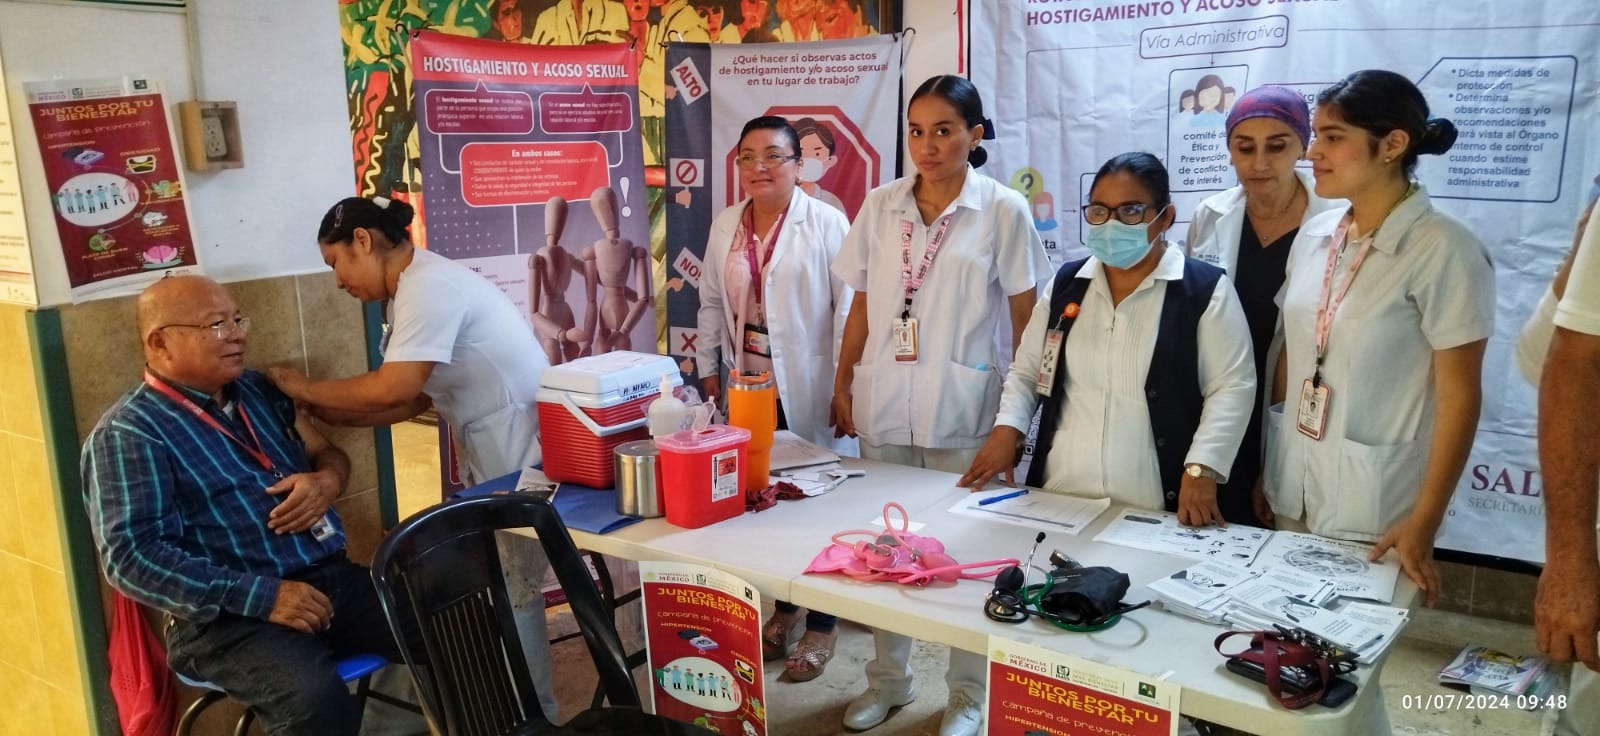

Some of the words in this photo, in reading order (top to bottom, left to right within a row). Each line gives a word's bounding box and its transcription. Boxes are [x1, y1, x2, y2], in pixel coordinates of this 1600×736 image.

[1026, 1, 1174, 26] HOSTIGAMIENTO
[1182, 0, 1191, 13] Y
[1146, 35, 1171, 49] Vía
[1175, 25, 1285, 47] Administrativa
[732, 54, 757, 66] ¿Qué
[760, 53, 788, 63] hacer
[791, 53, 799, 62] si
[801, 53, 846, 63] observas
[849, 51, 877, 61] actos
[424, 56, 527, 76] HOSTIGAMIENTO
[532, 62, 540, 76] Y
[544, 63, 583, 78] ACOSO
[586, 64, 629, 79] SEXUAL
[718, 65, 731, 75] de
[733, 65, 806, 77] hostigamiento
[808, 63, 823, 76] y/o
[825, 64, 854, 73] acoso
[857, 62, 889, 73] sexual
[1458, 68, 1485, 78] Dicta
[1487, 68, 1533, 78] medidas
[1536, 68, 1550, 78] de
[675, 64, 703, 99] ALTO
[747, 77, 759, 85] en
[762, 76, 773, 85] tu
[775, 76, 801, 88] lugar
[803, 75, 817, 85] de
[819, 74, 860, 87] trabajo?
[1456, 81, 1513, 92] protección
[1455, 93, 1509, 102] Determina
[40, 104, 95, 117] JUNTOS
[98, 101, 130, 113] POR
[134, 99, 154, 108] TU
[56, 108, 137, 122] BIENESTAR
[1454, 105, 1530, 115] observaciones
[1533, 106, 1551, 117] y/o
[1183, 130, 1217, 141] comité
[1478, 129, 1503, 139] vista
[1506, 129, 1516, 139] al
[1518, 129, 1559, 141] Órgano
[512, 149, 520, 157] En
[522, 148, 542, 157] ambos
[544, 149, 563, 157] casos:
[1489, 141, 1503, 151] de
[1505, 142, 1543, 152] control
[1180, 152, 1227, 163] Prevención
[1449, 153, 1488, 162] cuando
[1492, 154, 1529, 164] estime
[1178, 166, 1191, 175] de
[1447, 165, 1532, 177] responsabilidad
[1183, 177, 1195, 186] de
[1446, 178, 1521, 188] administrativa
[680, 257, 701, 281] NO!
[1471, 464, 1541, 498] SAL
[657, 587, 715, 601] JUNTOS
[718, 596, 742, 611] POR
[744, 608, 756, 621] TU
[676, 595, 746, 621] BIENESTAR
[1009, 658, 1047, 673] MÉXICO
[1006, 672, 1078, 700] JUNTOS
[1085, 694, 1126, 714] POR
[1131, 707, 1159, 723] TU
[1028, 687, 1135, 726] BIENESTAR
[1002, 699, 1054, 720] campaña
[1057, 713, 1072, 724] de
[1073, 719, 1132, 736] preven
